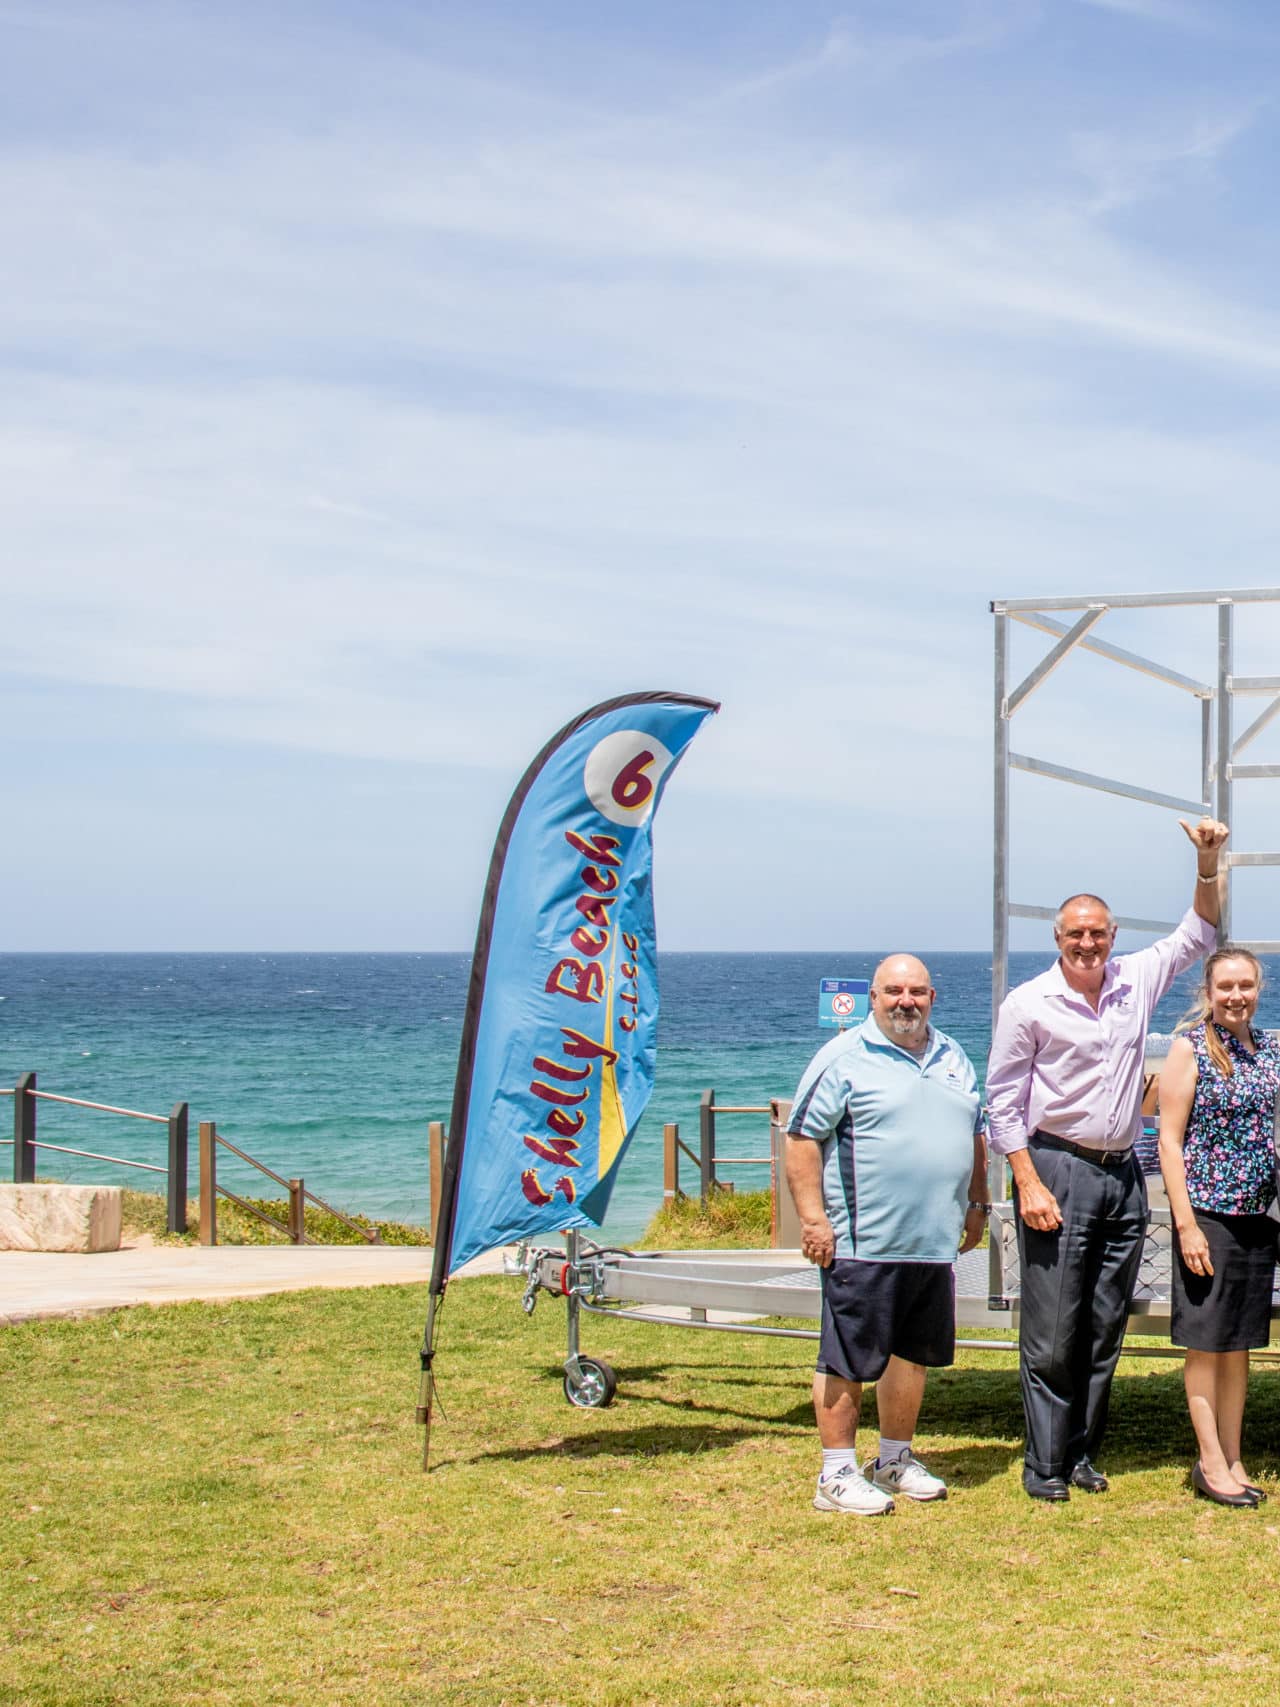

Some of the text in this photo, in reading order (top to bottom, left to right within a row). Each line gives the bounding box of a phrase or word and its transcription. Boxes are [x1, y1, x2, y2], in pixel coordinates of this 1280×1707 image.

[611, 750, 655, 811] 6
[521, 829, 623, 1207] Shelly Beach
